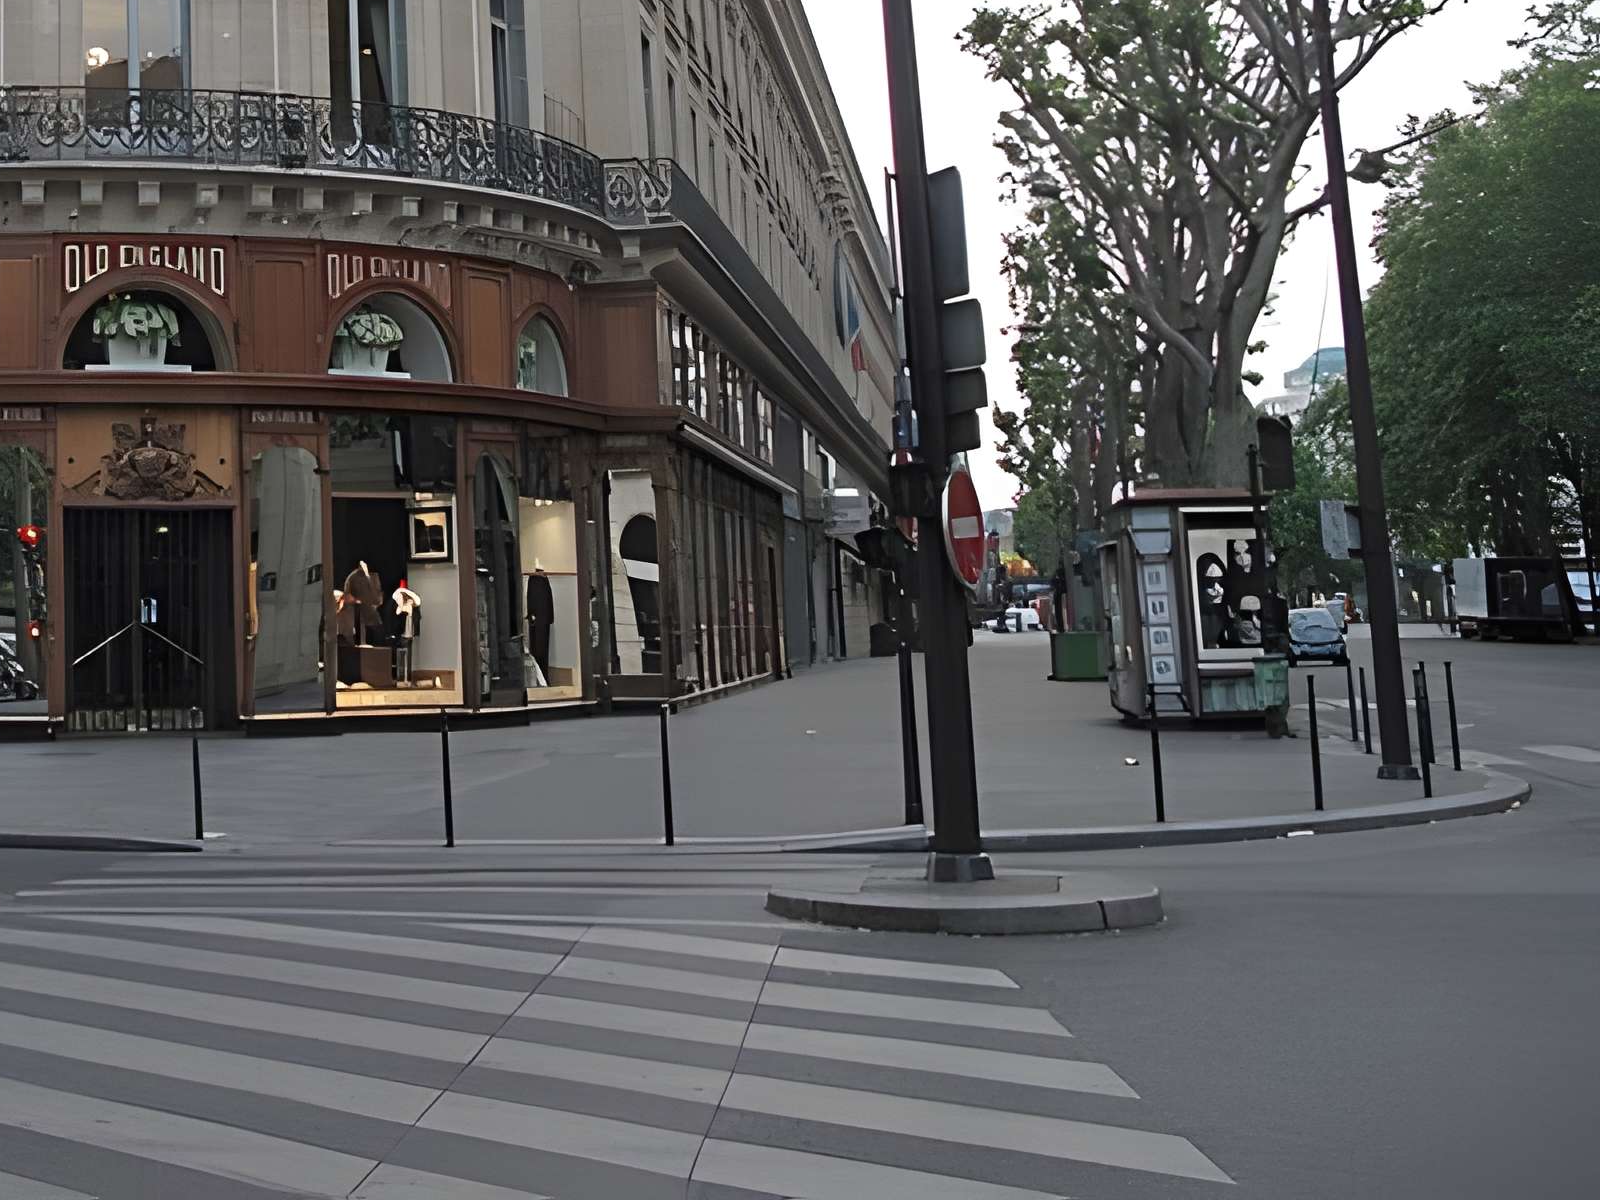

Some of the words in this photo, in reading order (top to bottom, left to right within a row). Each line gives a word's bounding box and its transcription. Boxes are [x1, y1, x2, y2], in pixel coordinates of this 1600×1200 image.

[65, 244, 108, 293] OLD
[119, 245, 225, 296] ENGLAND
[327, 253, 364, 299] OLD
